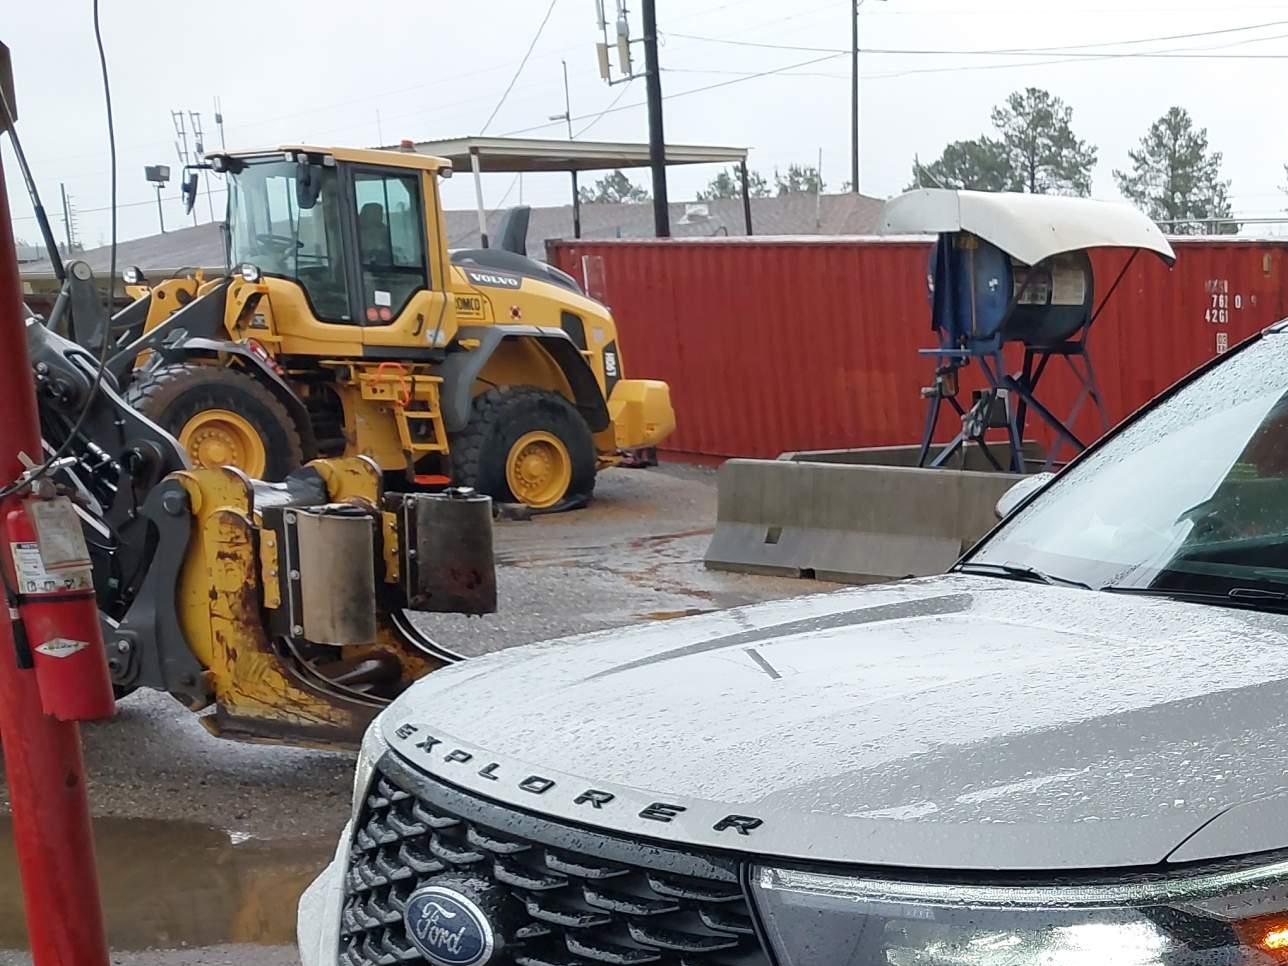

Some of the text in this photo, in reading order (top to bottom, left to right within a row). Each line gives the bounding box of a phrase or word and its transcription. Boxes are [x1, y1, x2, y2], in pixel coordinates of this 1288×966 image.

[470, 272, 518, 286] VOLVO
[395, 723, 764, 836] EXPLORER
[416, 902, 465, 955] Ford
